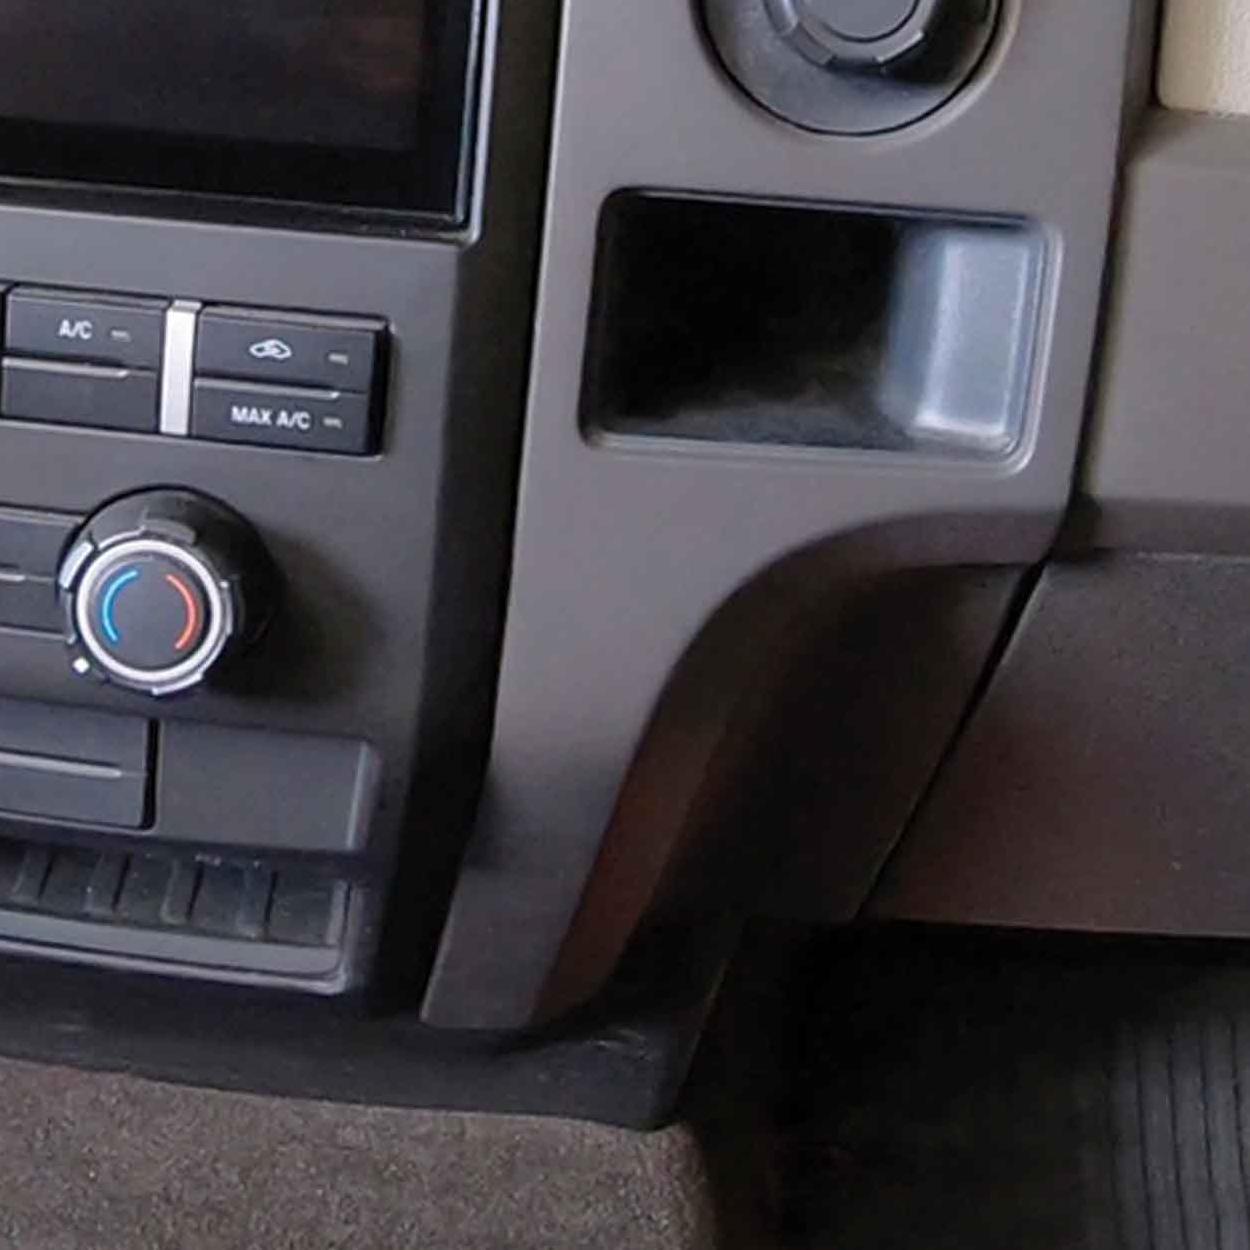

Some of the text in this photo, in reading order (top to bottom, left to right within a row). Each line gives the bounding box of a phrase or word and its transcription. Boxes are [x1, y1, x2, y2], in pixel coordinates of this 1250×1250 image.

[59, 319, 92, 340] A/C
[231, 406, 311, 430] MAX A/C
